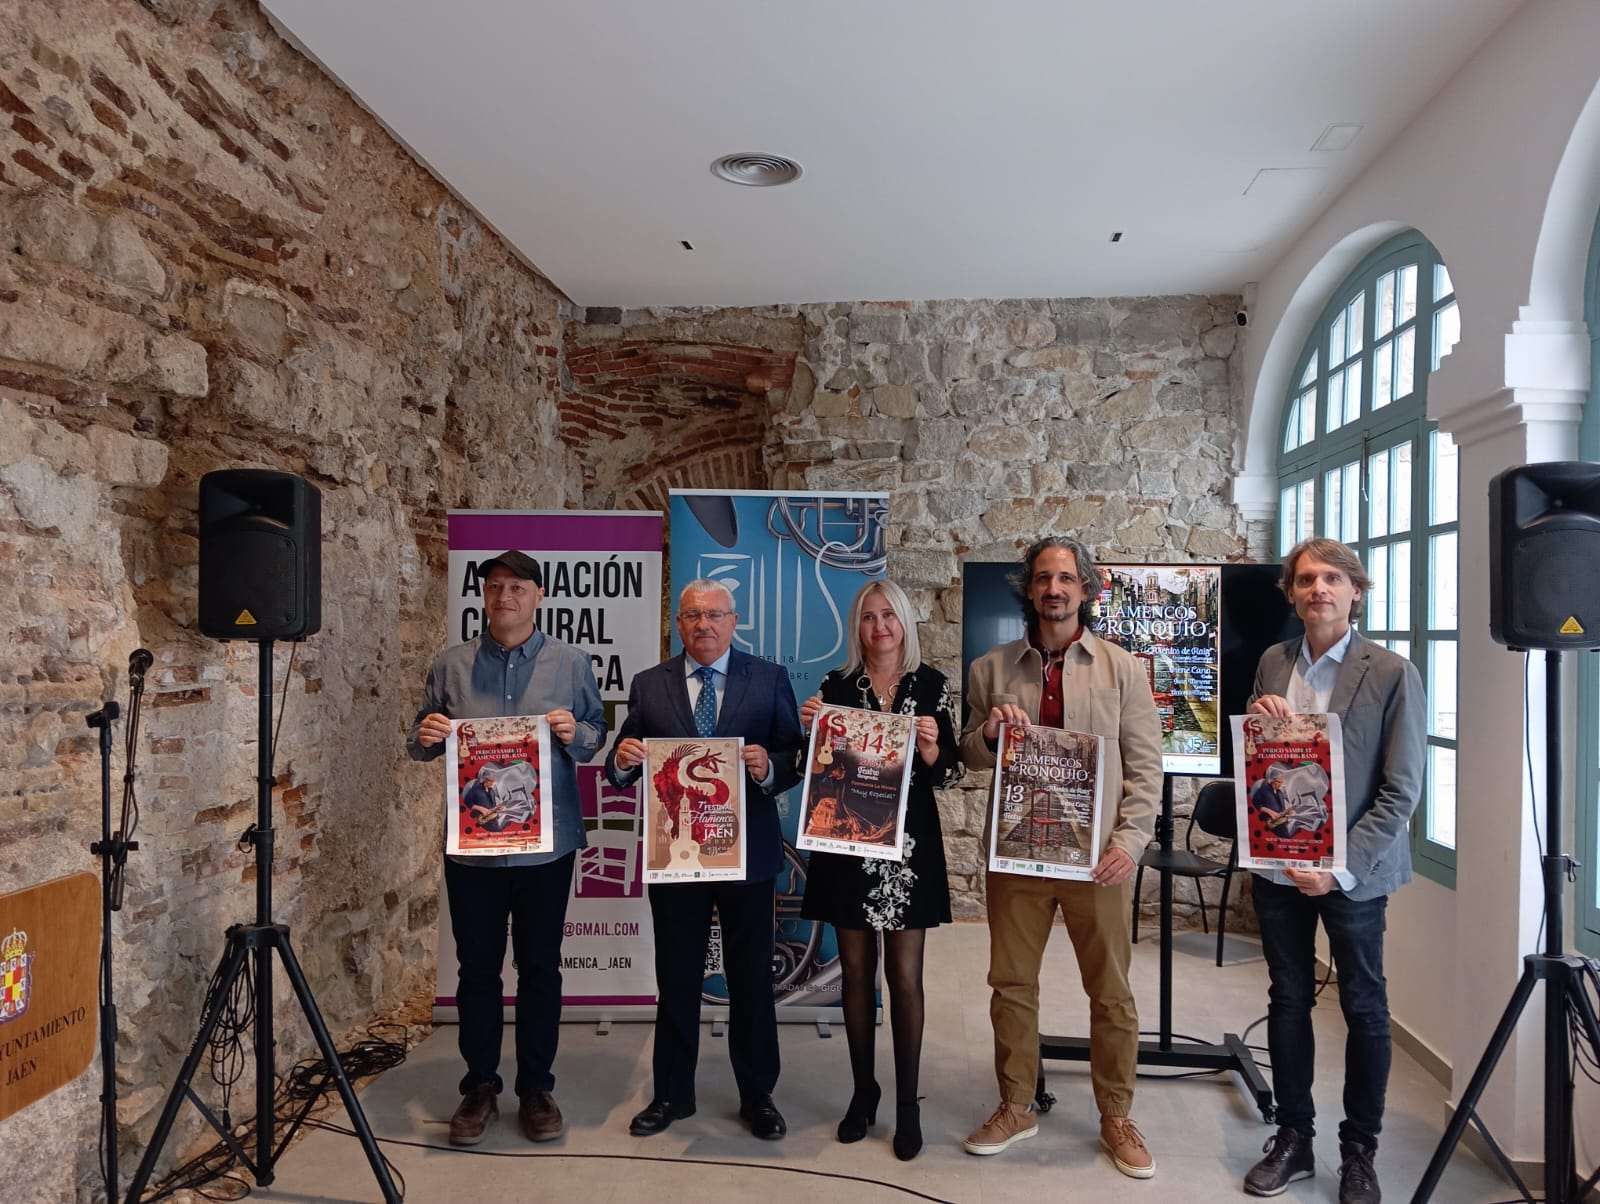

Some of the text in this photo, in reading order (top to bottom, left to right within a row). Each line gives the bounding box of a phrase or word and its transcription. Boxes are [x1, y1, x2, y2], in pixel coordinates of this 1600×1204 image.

[461, 554, 642, 598] AIACIÓN
[1097, 606, 1197, 620] FLAMENCOS
[461, 607, 613, 644] CURAL
[783, 655, 794, 663] 18
[861, 733, 884, 754] 14
[1012, 753, 1082, 769] FLAMENCOS
[1005, 784, 1024, 803] 13
[686, 810, 734, 825] Flamenco
[702, 825, 733, 841] JAÉN
[563, 922, 639, 937] @GMAIL.COM
[0, 1006, 86, 1061] YUNTAMIENTO
[5, 1056, 37, 1087] JAÉN
